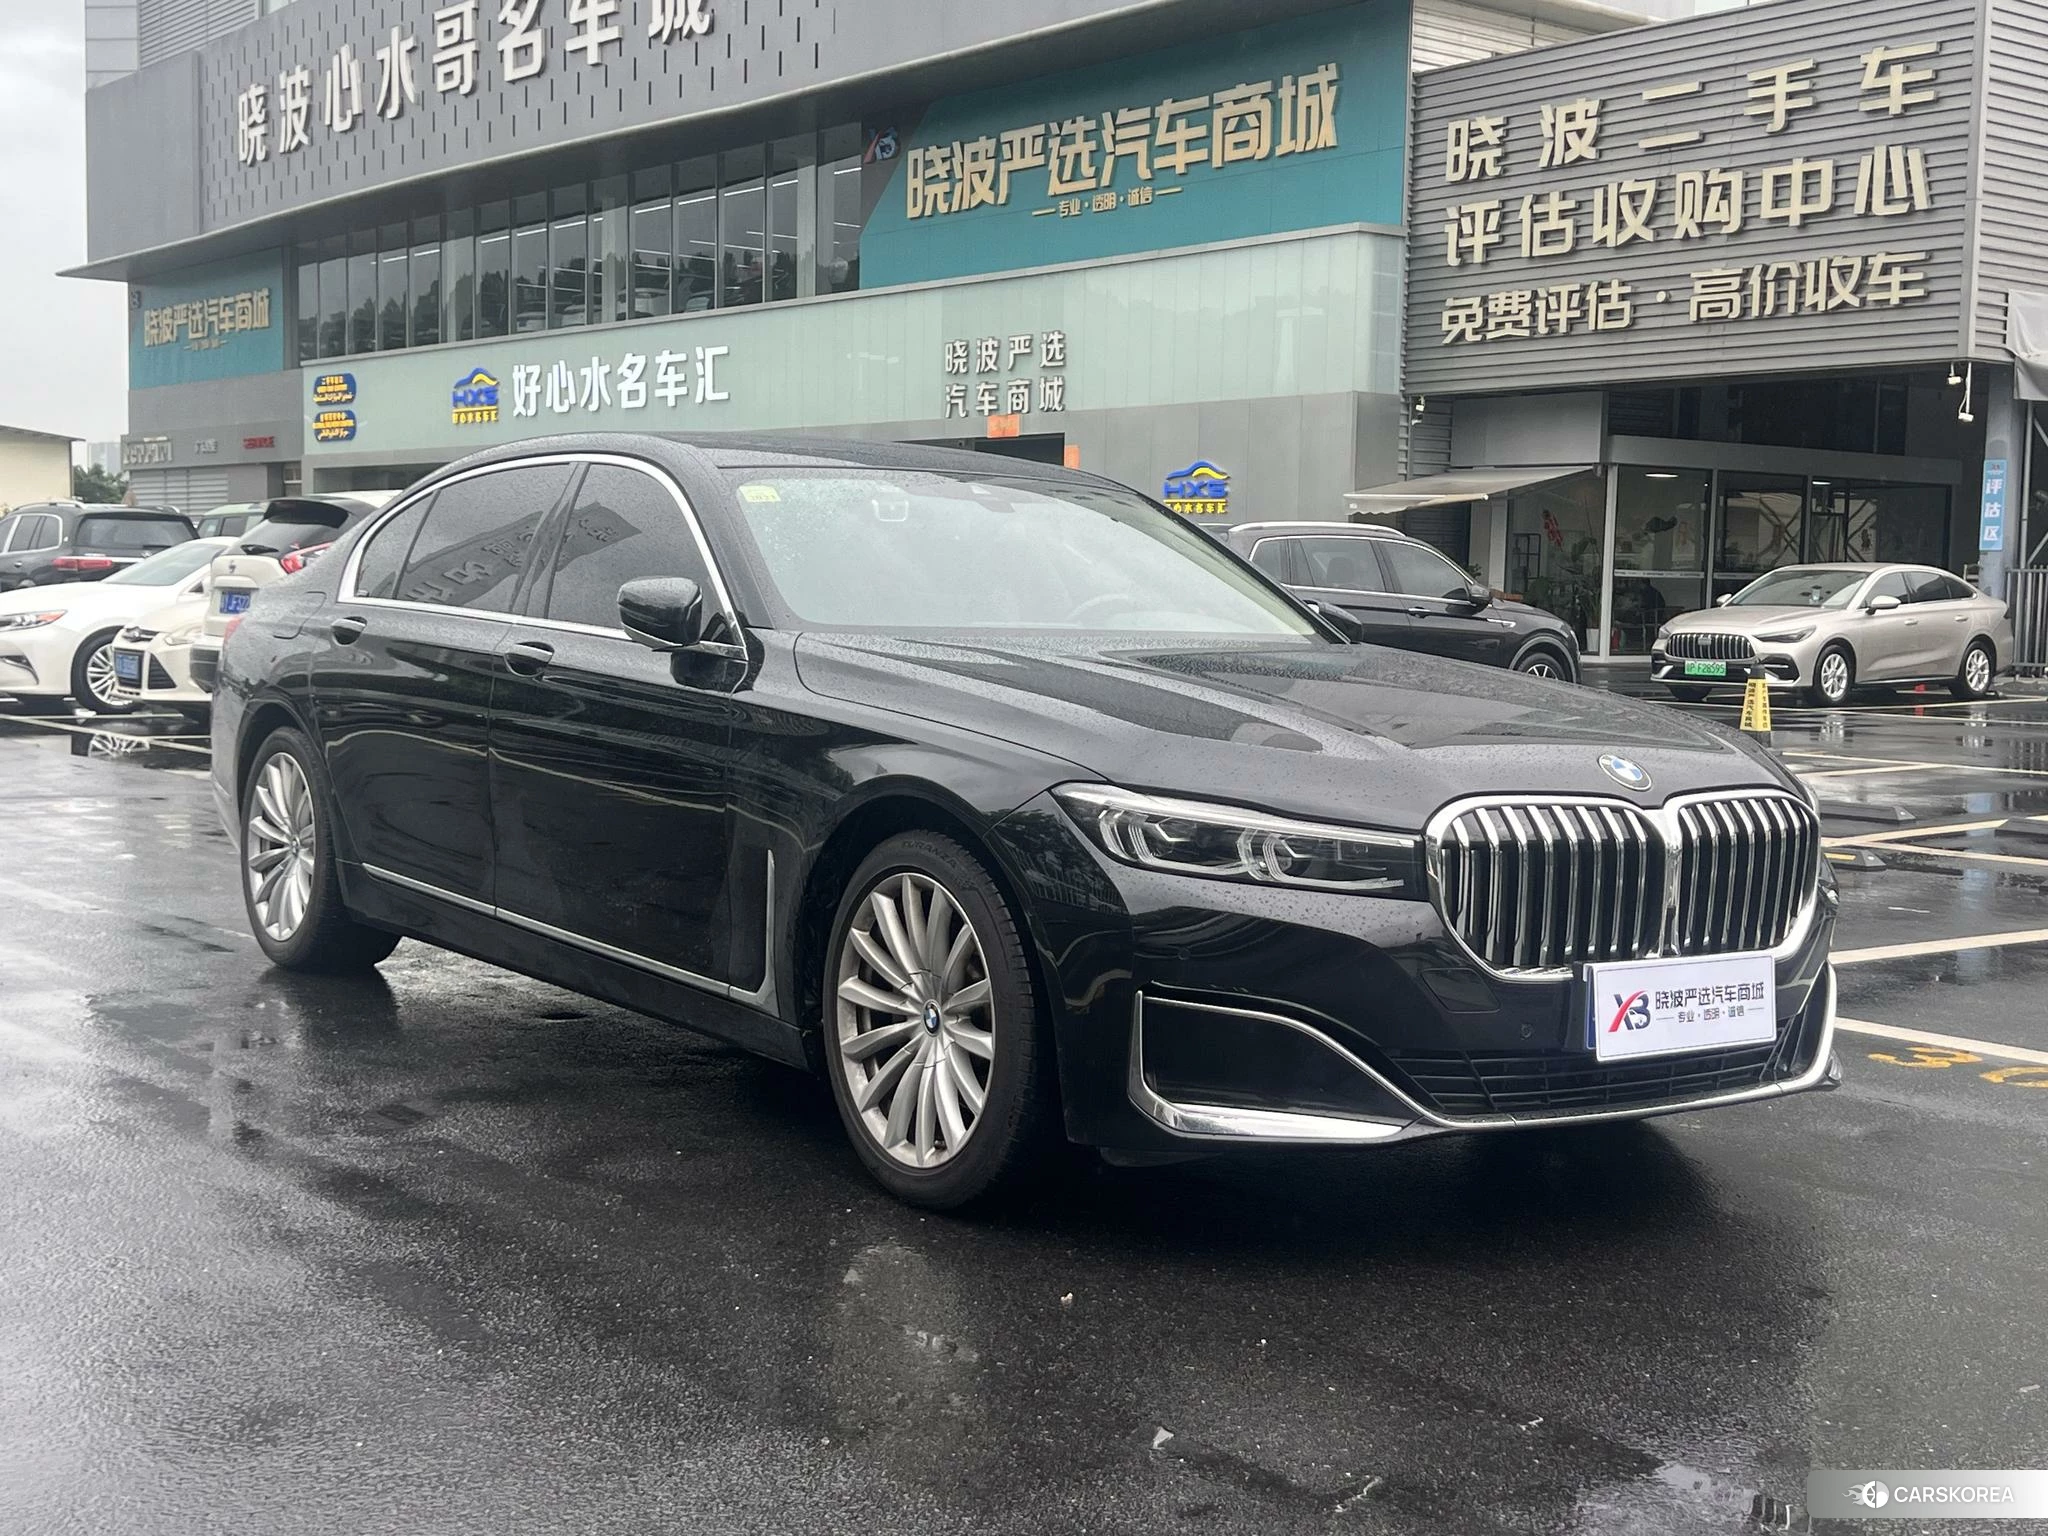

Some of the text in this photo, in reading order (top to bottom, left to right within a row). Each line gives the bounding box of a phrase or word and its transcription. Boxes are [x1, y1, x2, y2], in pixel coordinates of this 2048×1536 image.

[906, 62, 1339, 220] 晓波严选汽车商城
[1444, 41, 1942, 183] 晓波二手车
[1444, 145, 1931, 268] 评估收购中心
[511, 345, 730, 418] 好心水名车汇
[945, 331, 1066, 375] 晓波严选
[945, 376, 1065, 418] 汽车商城
[1983, 478, 2003, 541] 评估区
[1655, 981, 1764, 1010] 晓波严选汽车商城
